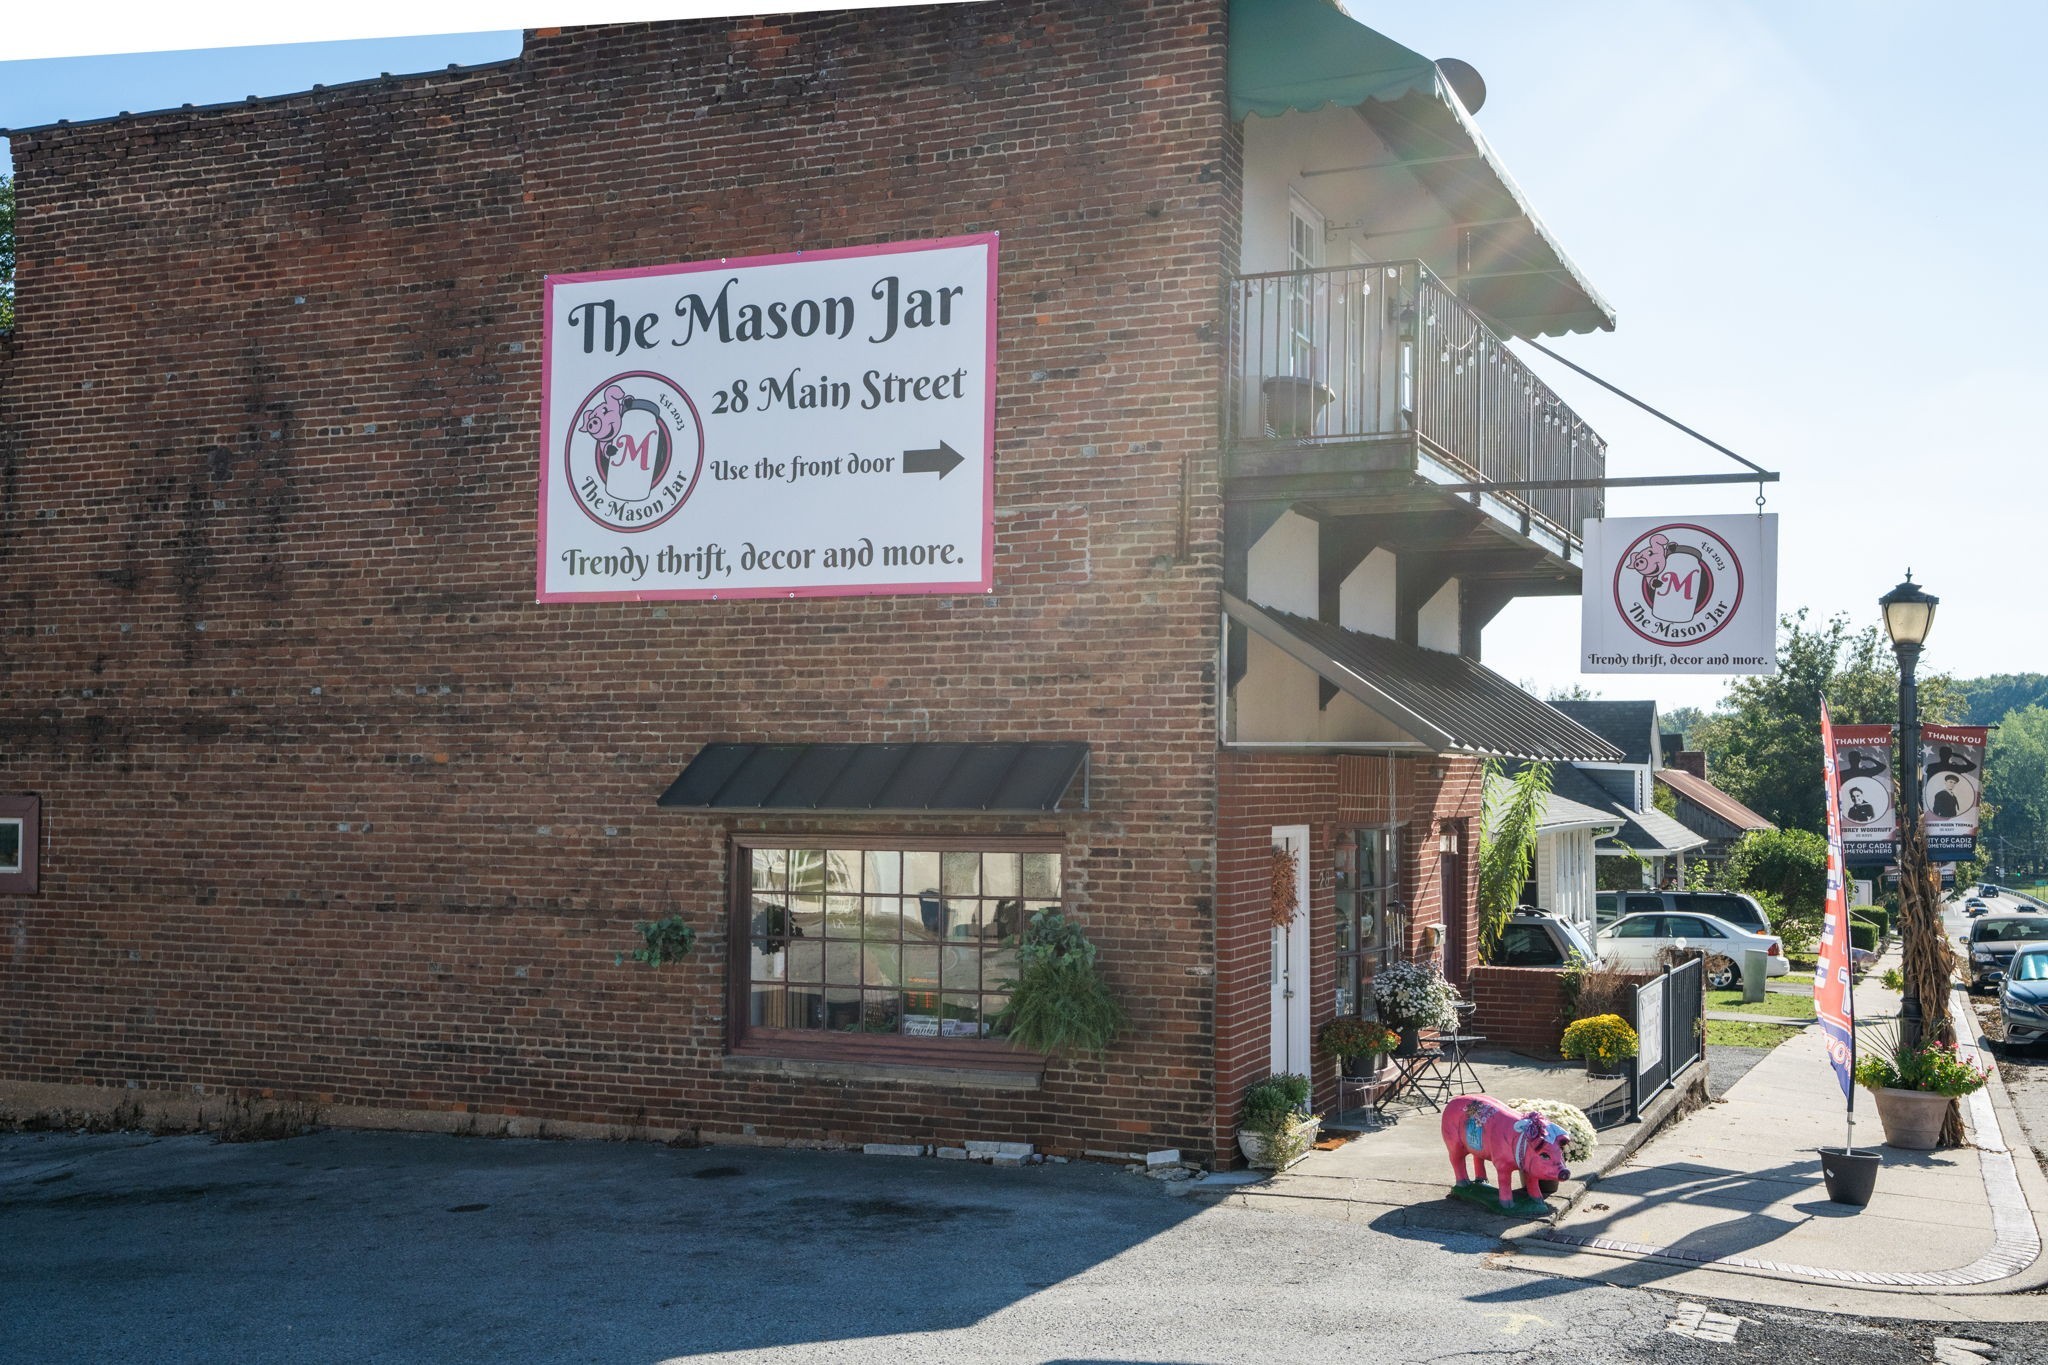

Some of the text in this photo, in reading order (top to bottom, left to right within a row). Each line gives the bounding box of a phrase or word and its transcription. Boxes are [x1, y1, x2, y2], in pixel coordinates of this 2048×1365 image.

[568, 275, 964, 357] The Mason Jar
[711, 367, 968, 415] 28 Main Street
[659, 392, 685, 432] Est 2023
[610, 429, 658, 471] M
[709, 452, 896, 484] Use the front door
[581, 470, 688, 522] The Mason Jar
[561, 537, 964, 582] Trendy thrift, decor and more.
[1701, 541, 1726, 571] Est 2023
[1656, 569, 1700, 601] M
[1629, 600, 1728, 638] The Mason Jar
[1587, 653, 1768, 668] Trendy thrift, decor and more.
[1835, 737, 1866, 745] THANK
[1927, 731, 1981, 744] THANK YOU
